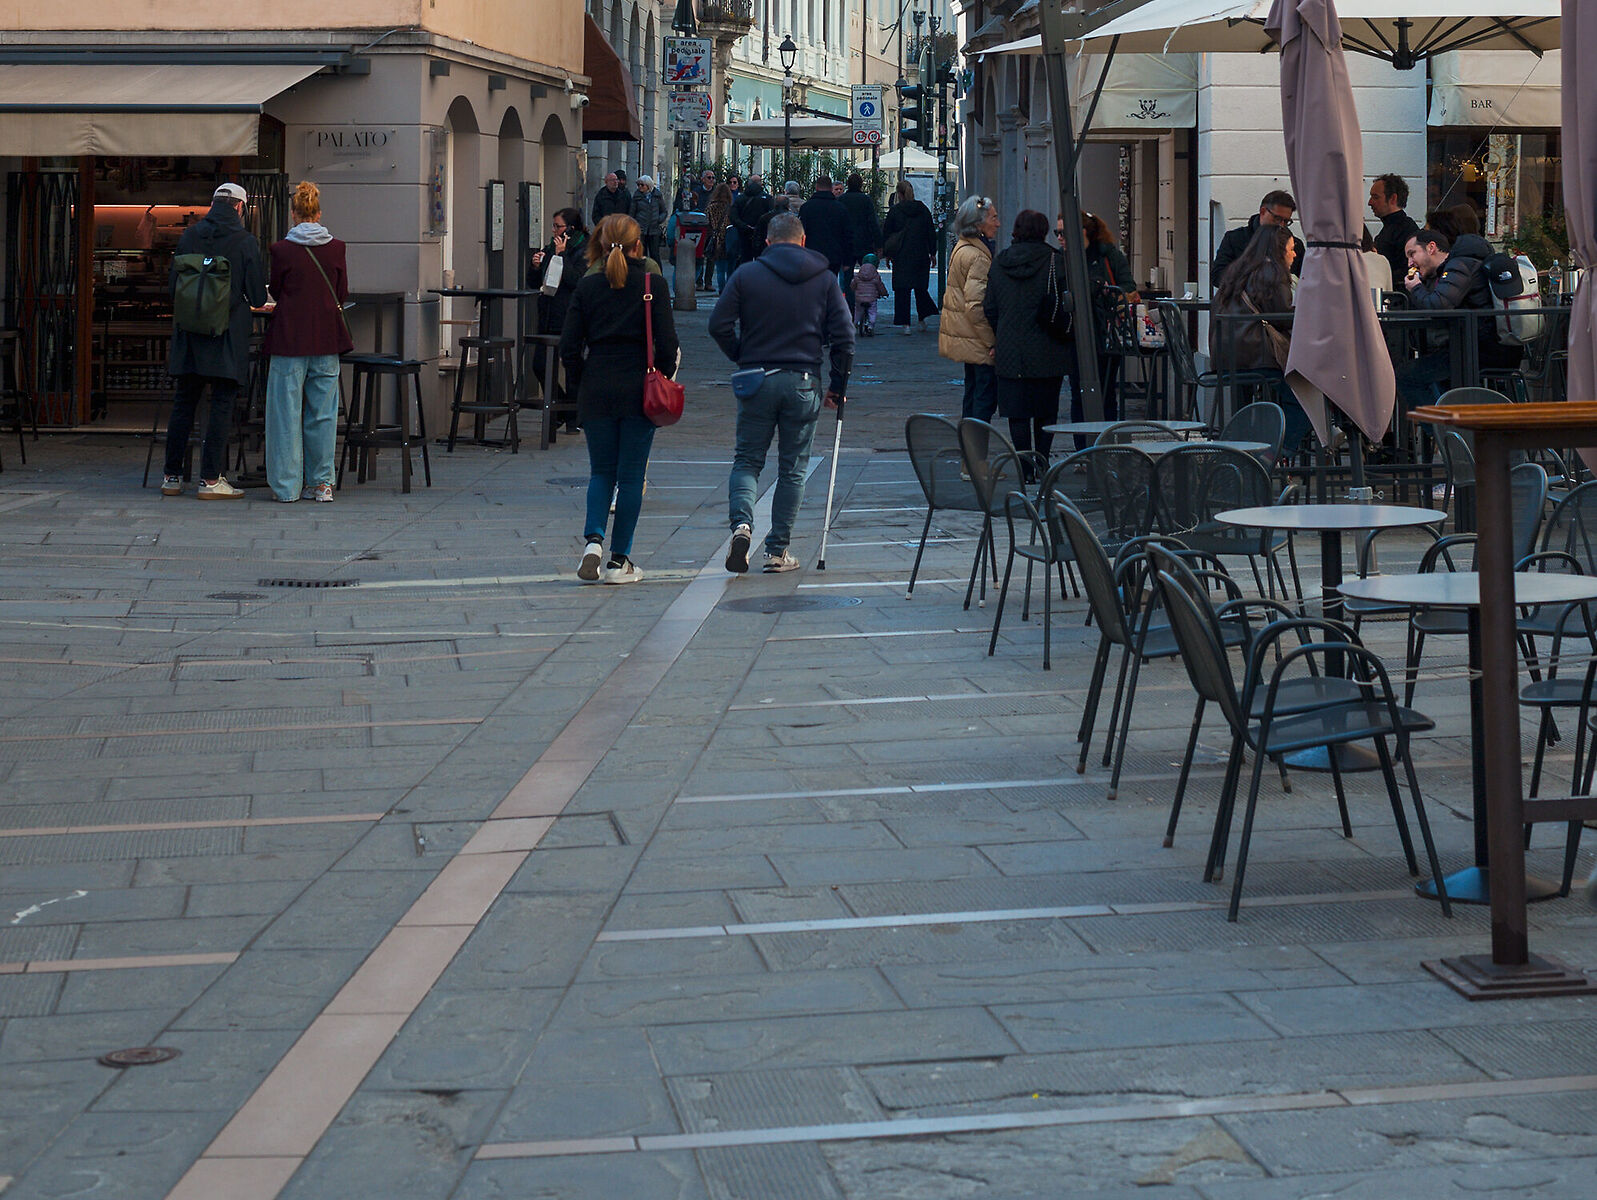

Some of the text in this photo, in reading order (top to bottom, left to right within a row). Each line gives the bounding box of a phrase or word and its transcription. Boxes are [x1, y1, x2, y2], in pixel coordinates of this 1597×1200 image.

[671, 47, 706, 55] pedale
[1471, 100, 1492, 108] BAR
[318, 131, 387, 148] PALATO
